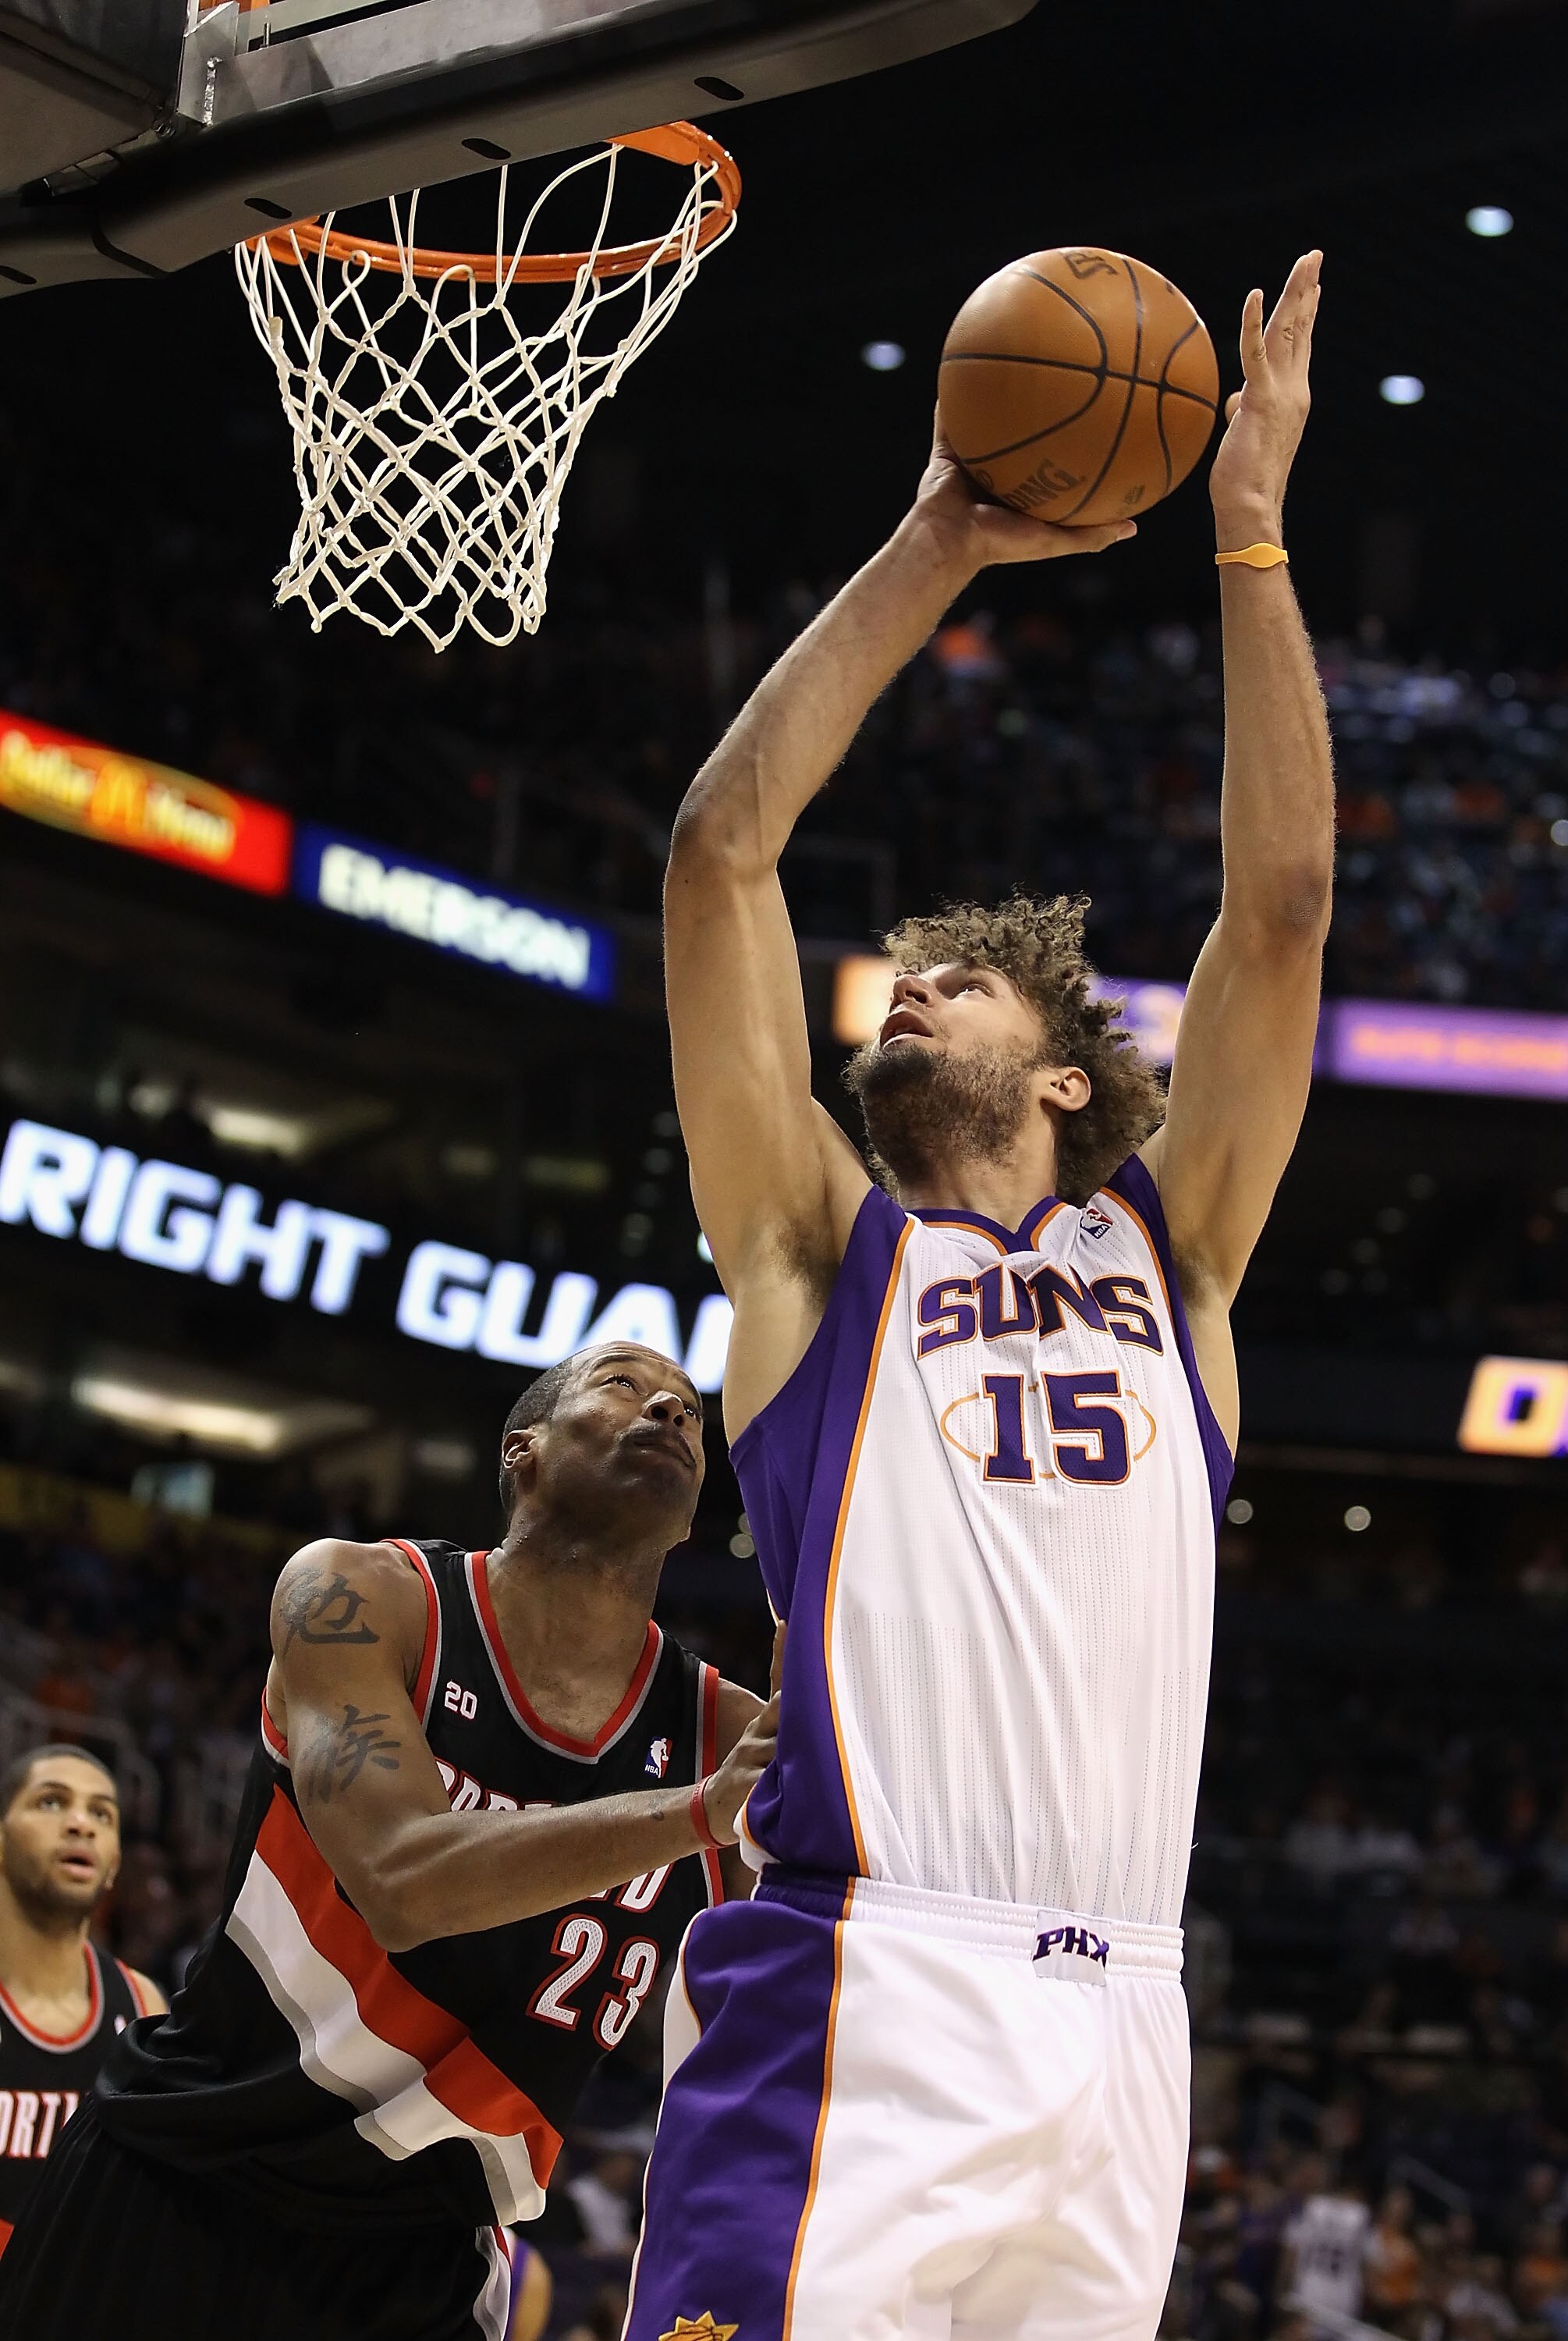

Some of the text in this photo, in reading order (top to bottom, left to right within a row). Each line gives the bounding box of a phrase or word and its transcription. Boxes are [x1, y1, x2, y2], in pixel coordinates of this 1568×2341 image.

[318, 844, 590, 989] EMERSON
[0, 1118, 390, 1315] RIGHT
[917, 1263, 1163, 1360] SUNS
[981, 1370, 1130, 1485] 15
[444, 1680, 477, 1720] 20
[644, 1764, 659, 1776] NBA
[526, 1913, 660, 2051] 23
[1032, 1926, 1109, 1968] PHX
